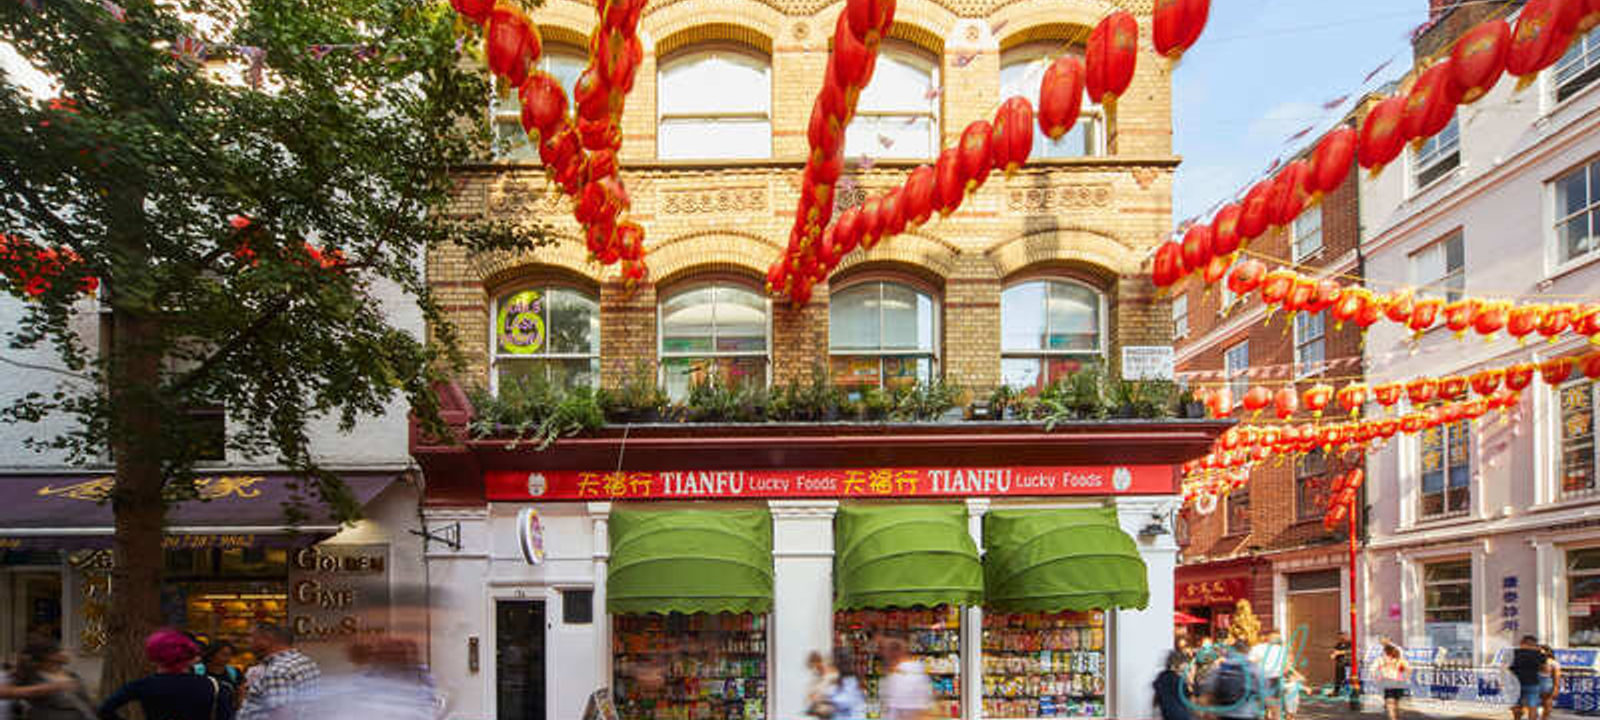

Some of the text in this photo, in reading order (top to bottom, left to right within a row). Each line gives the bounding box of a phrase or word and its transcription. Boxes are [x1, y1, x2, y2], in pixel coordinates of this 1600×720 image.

[578, 470, 838, 496] 天福行 TIANFU Lucky Foods
[843, 469, 1103, 495] 天福行 TIANFU Lucky Foods
[294, 545, 385, 572] GOLDEN
